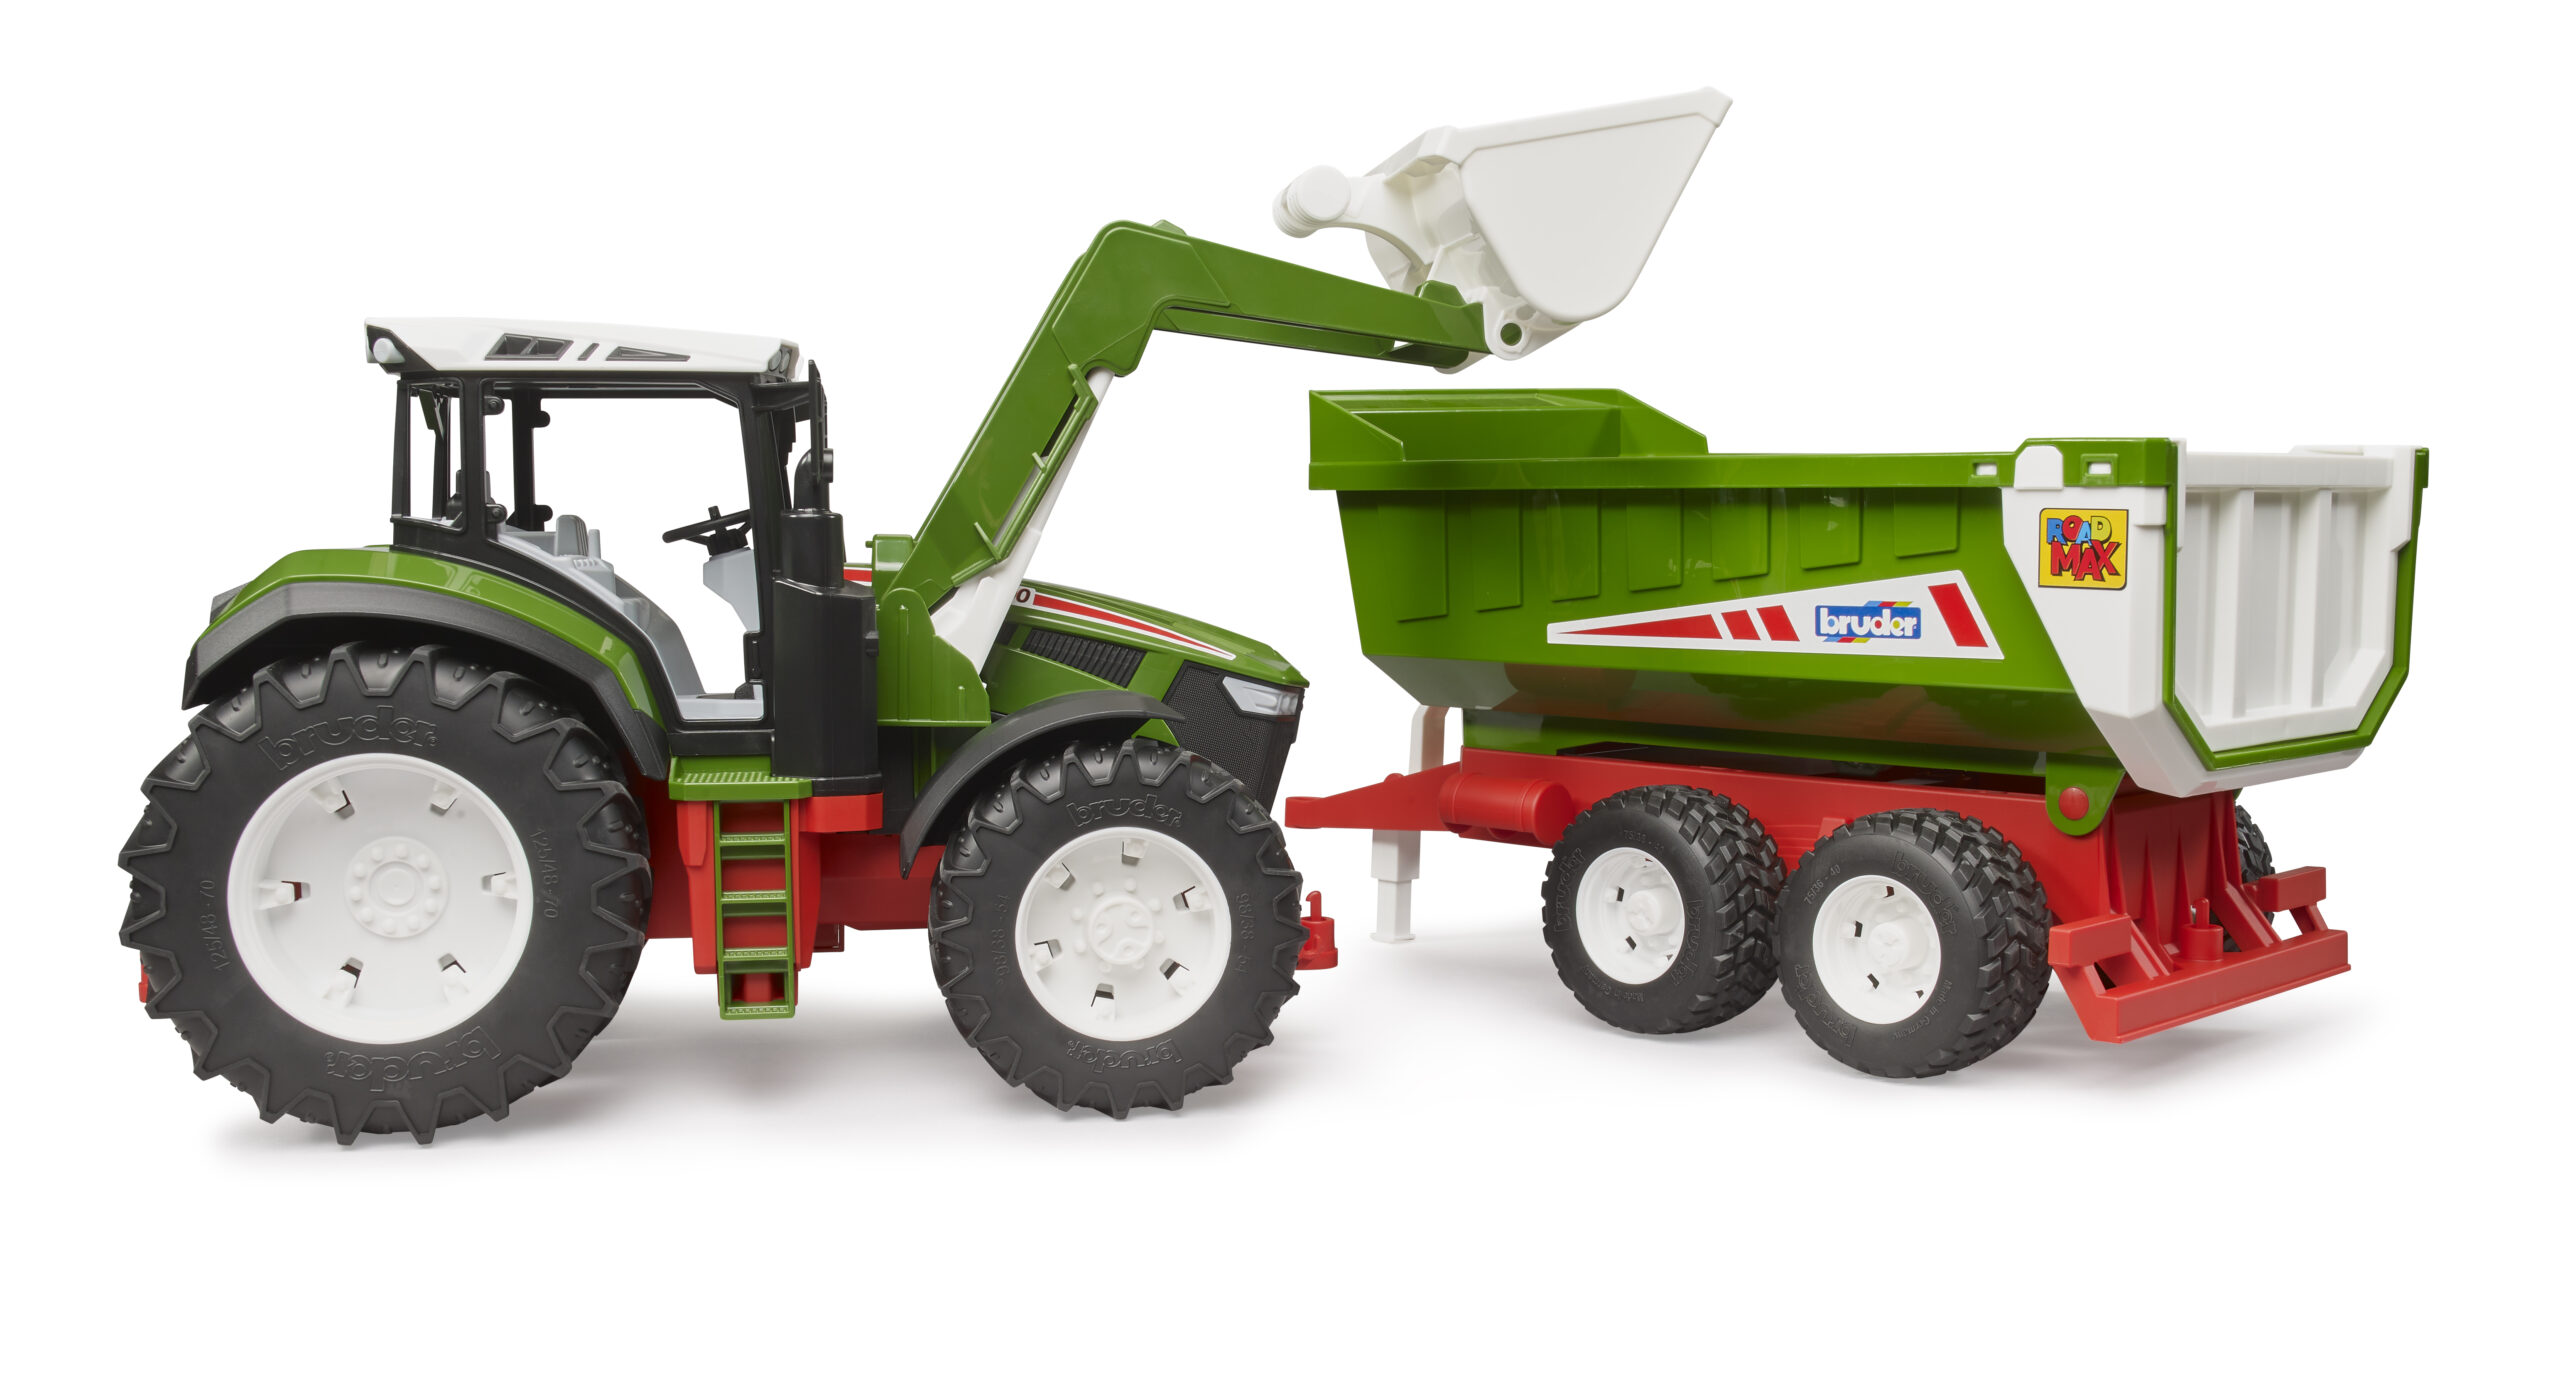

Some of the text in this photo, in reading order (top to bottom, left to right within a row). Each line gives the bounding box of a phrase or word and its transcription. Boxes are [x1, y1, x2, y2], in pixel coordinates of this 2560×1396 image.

[2046, 515, 2113, 545] ROAD
[2050, 540, 2122, 582] MAX
[1820, 607, 1917, 637] bruder
[257, 705, 438, 771] bruder
[1066, 794, 1183, 828] bruder
[330, 1026, 503, 1093] bruder
[1066, 1039, 1184, 1073] bruder
